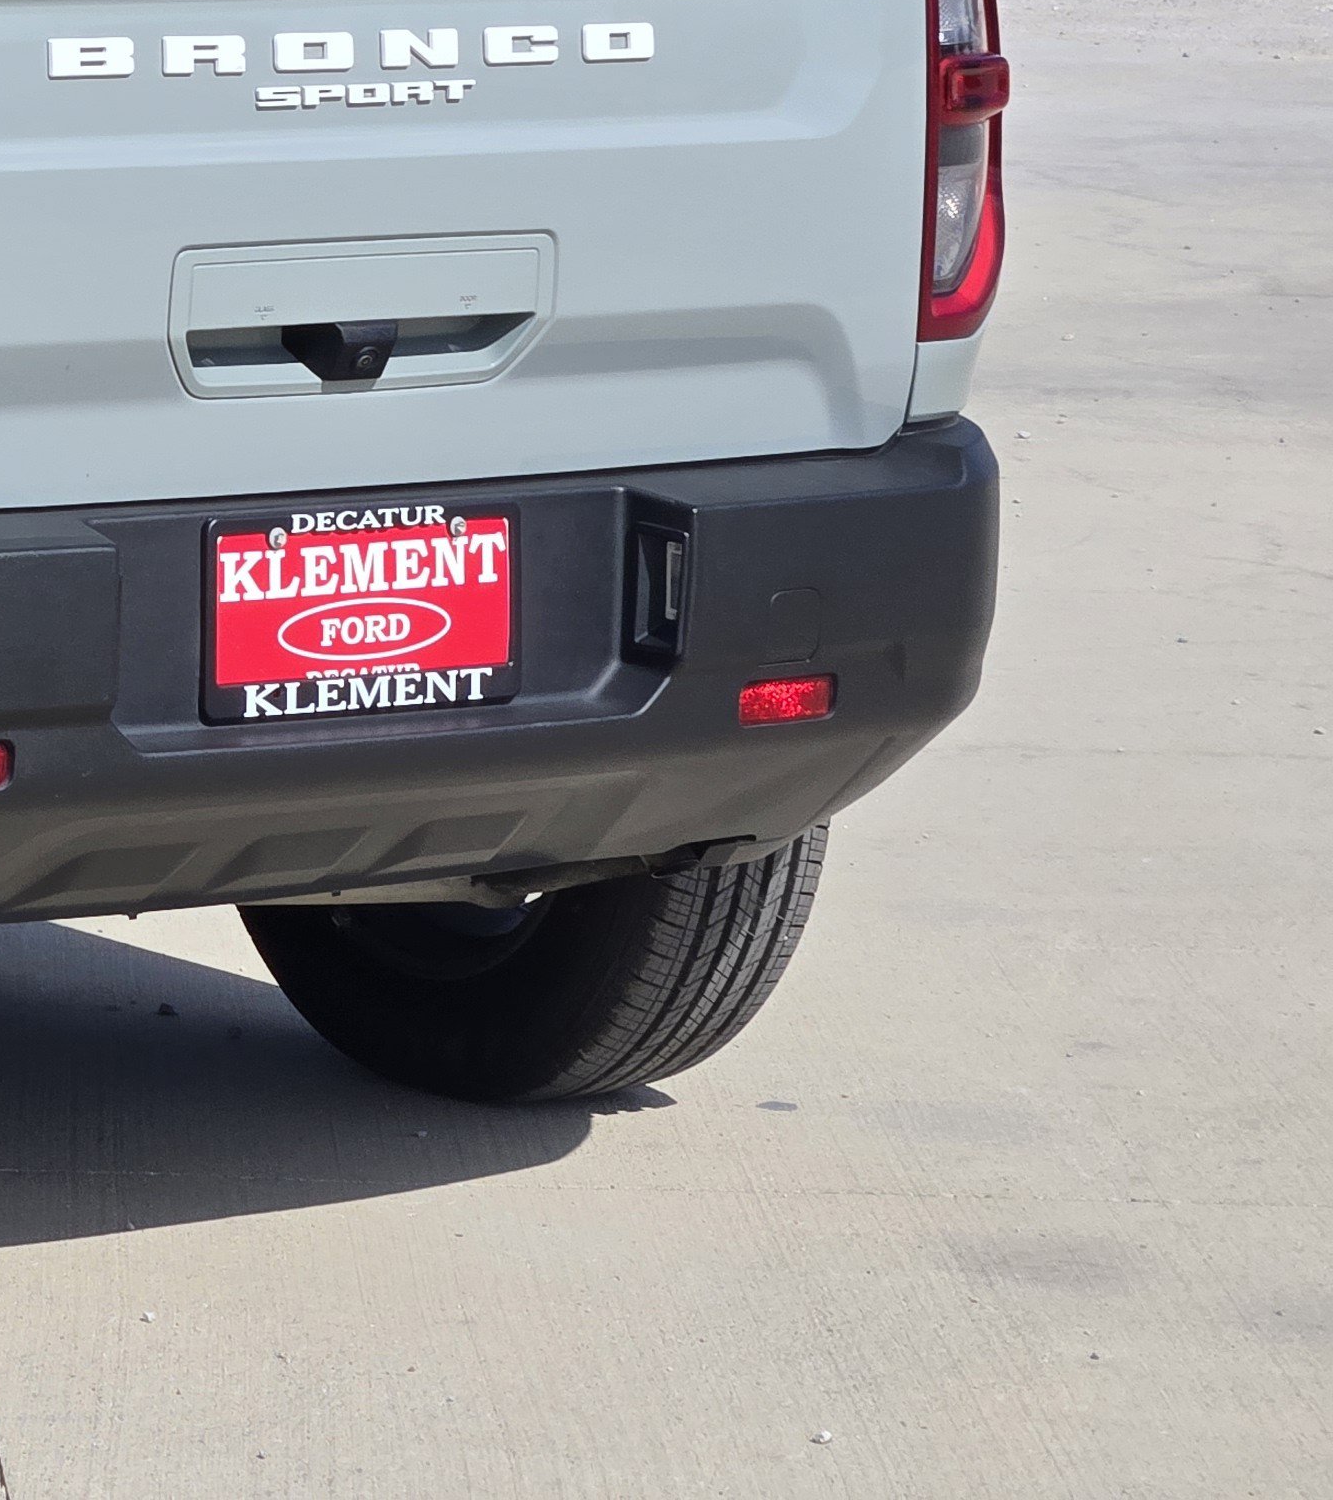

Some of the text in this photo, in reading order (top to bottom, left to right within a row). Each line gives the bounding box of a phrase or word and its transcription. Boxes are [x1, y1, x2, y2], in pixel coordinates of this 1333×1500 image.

[46, 22, 656, 79] BRONCO
[255, 79, 477, 110] SPORT
[290, 504, 447, 535] DECATUR
[219, 531, 507, 603] KLEMENT
[320, 613, 412, 647] FORD
[243, 667, 493, 718] KLEMENT
